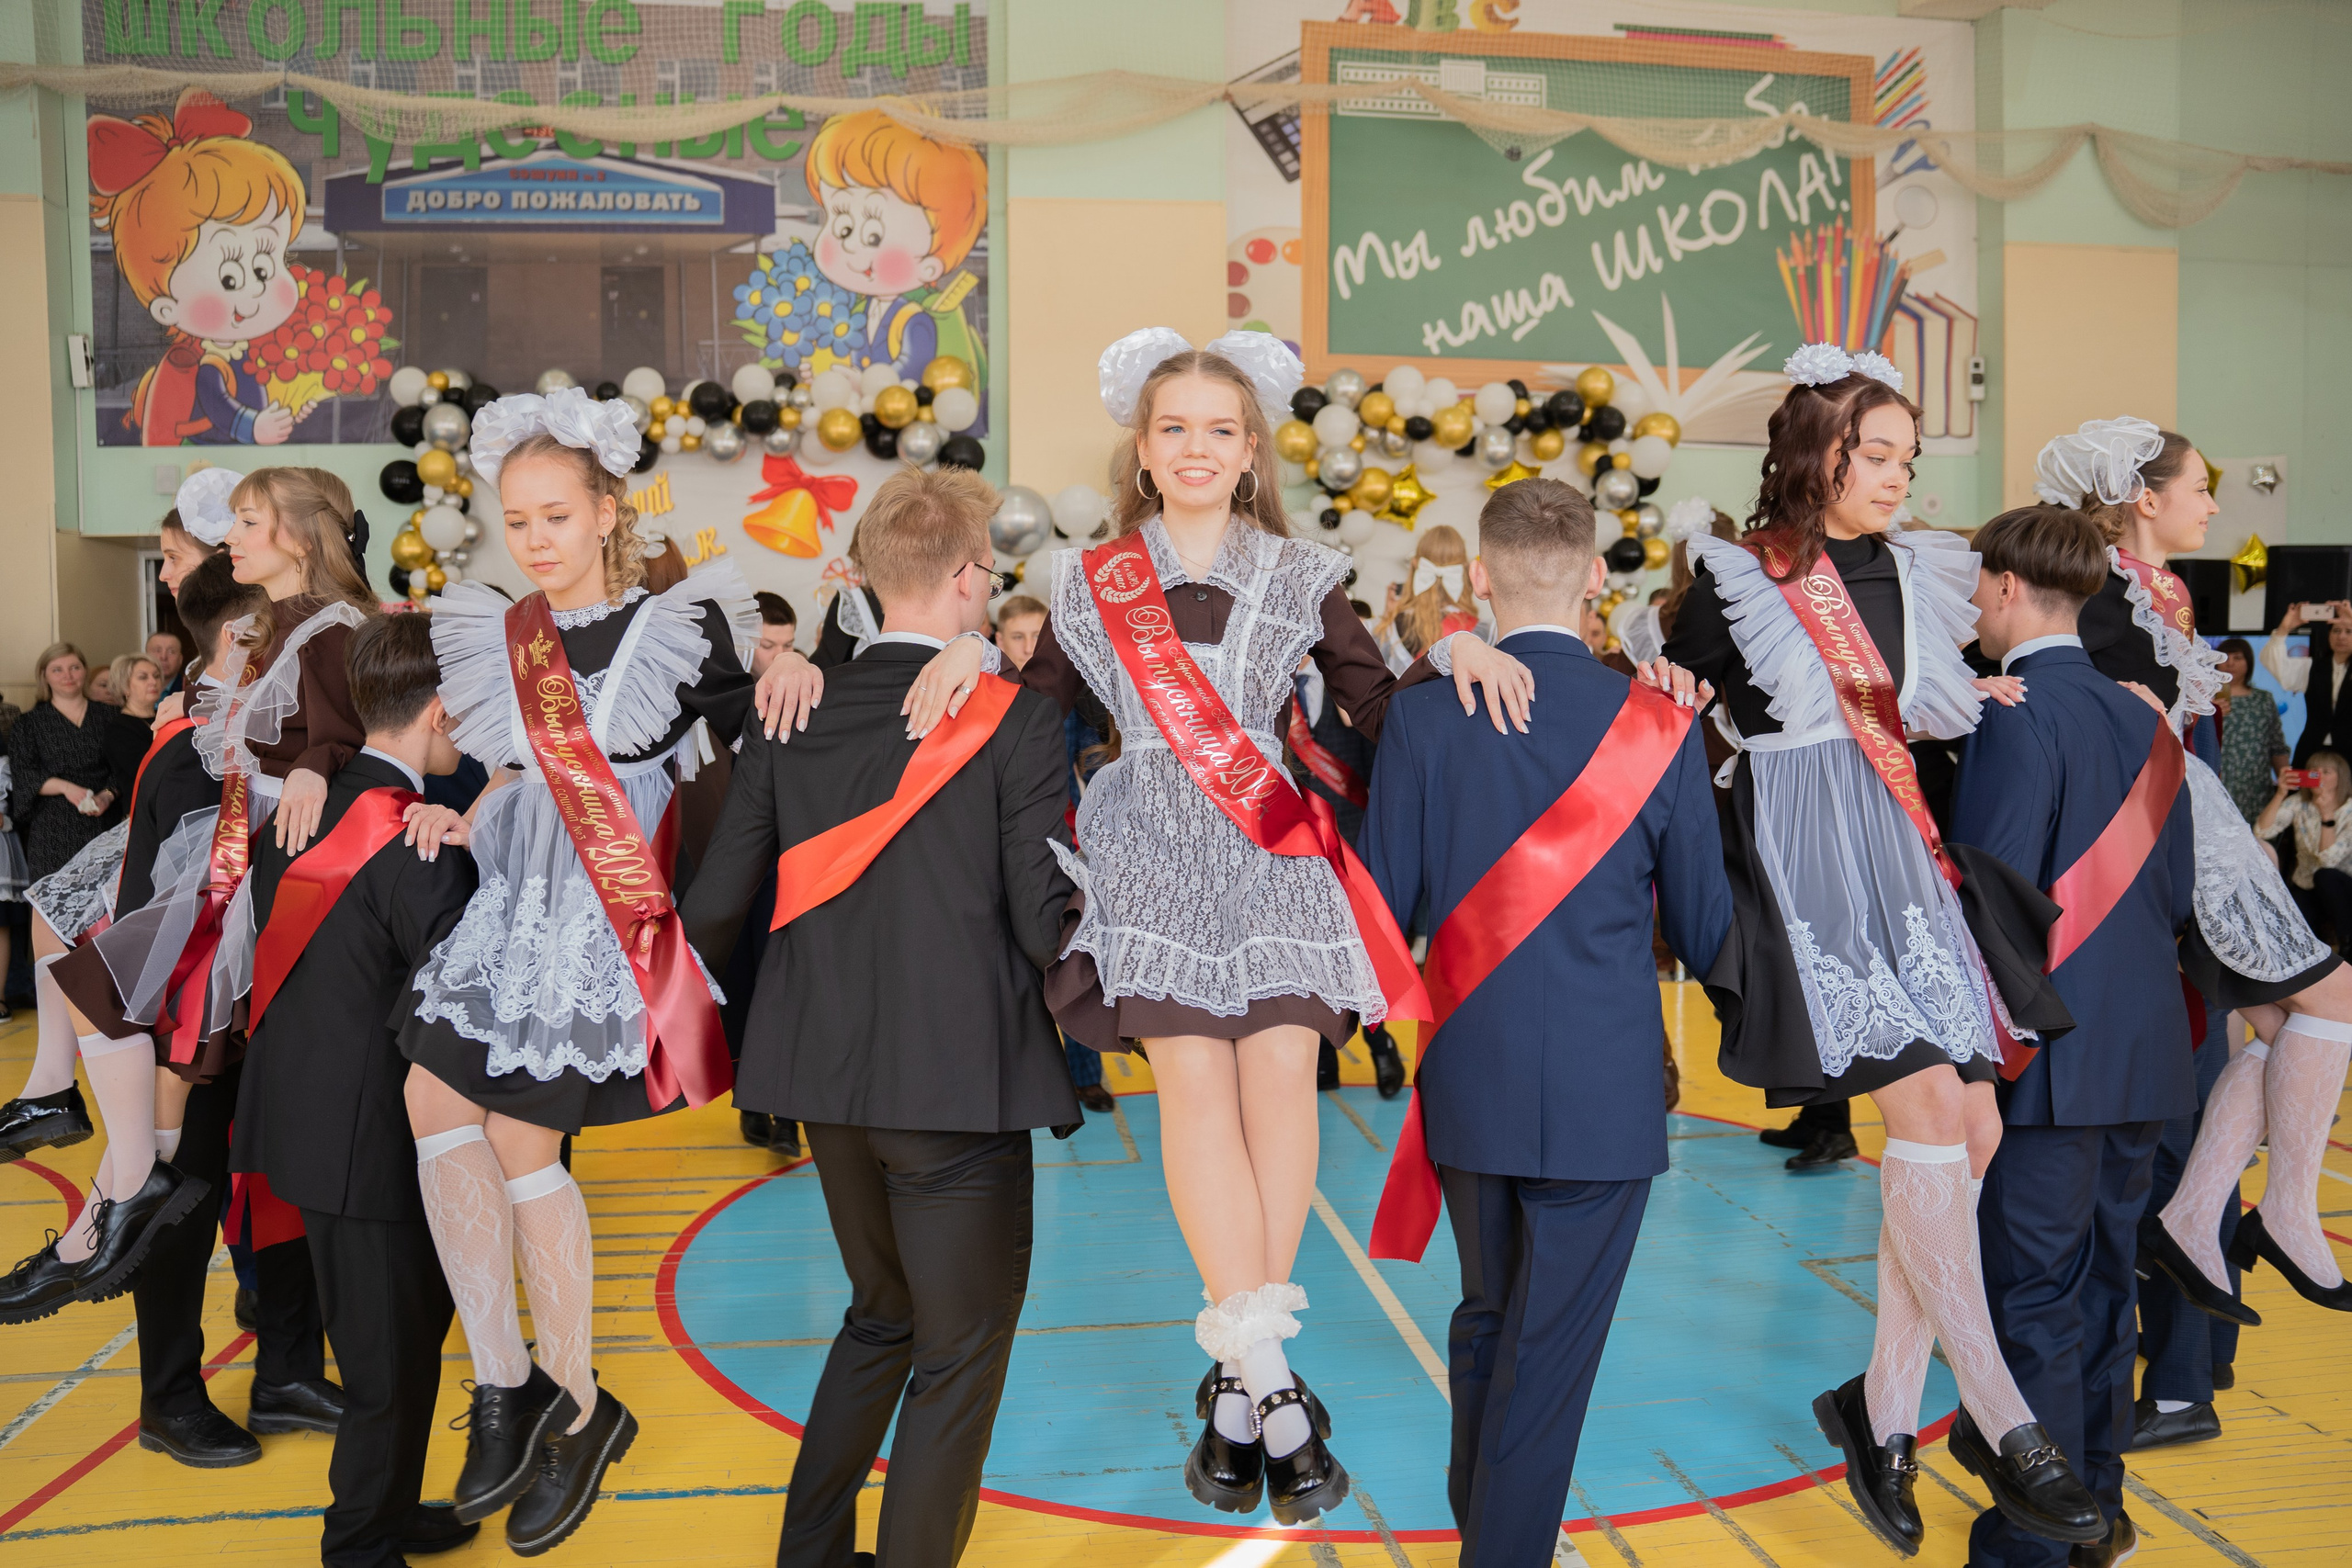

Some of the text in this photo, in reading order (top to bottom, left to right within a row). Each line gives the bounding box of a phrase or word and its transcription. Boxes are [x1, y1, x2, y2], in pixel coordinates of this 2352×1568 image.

[406, 190, 702, 212] ДОБРО ПОЖАЛОВАТЬ
[1334, 149, 1665, 299] Мы любим
[1422, 147, 1850, 355] наша ШКОЛА!
[1125, 605, 1234, 768] Выпускница
[1801, 574, 1927, 813] Выпускница 2024
[1829, 662, 1847, 689] МБОУ
[537, 674, 664, 906] Выпускница 2024
[544, 761, 562, 785] МБОУ
[602, 775, 627, 819] Ангелина
